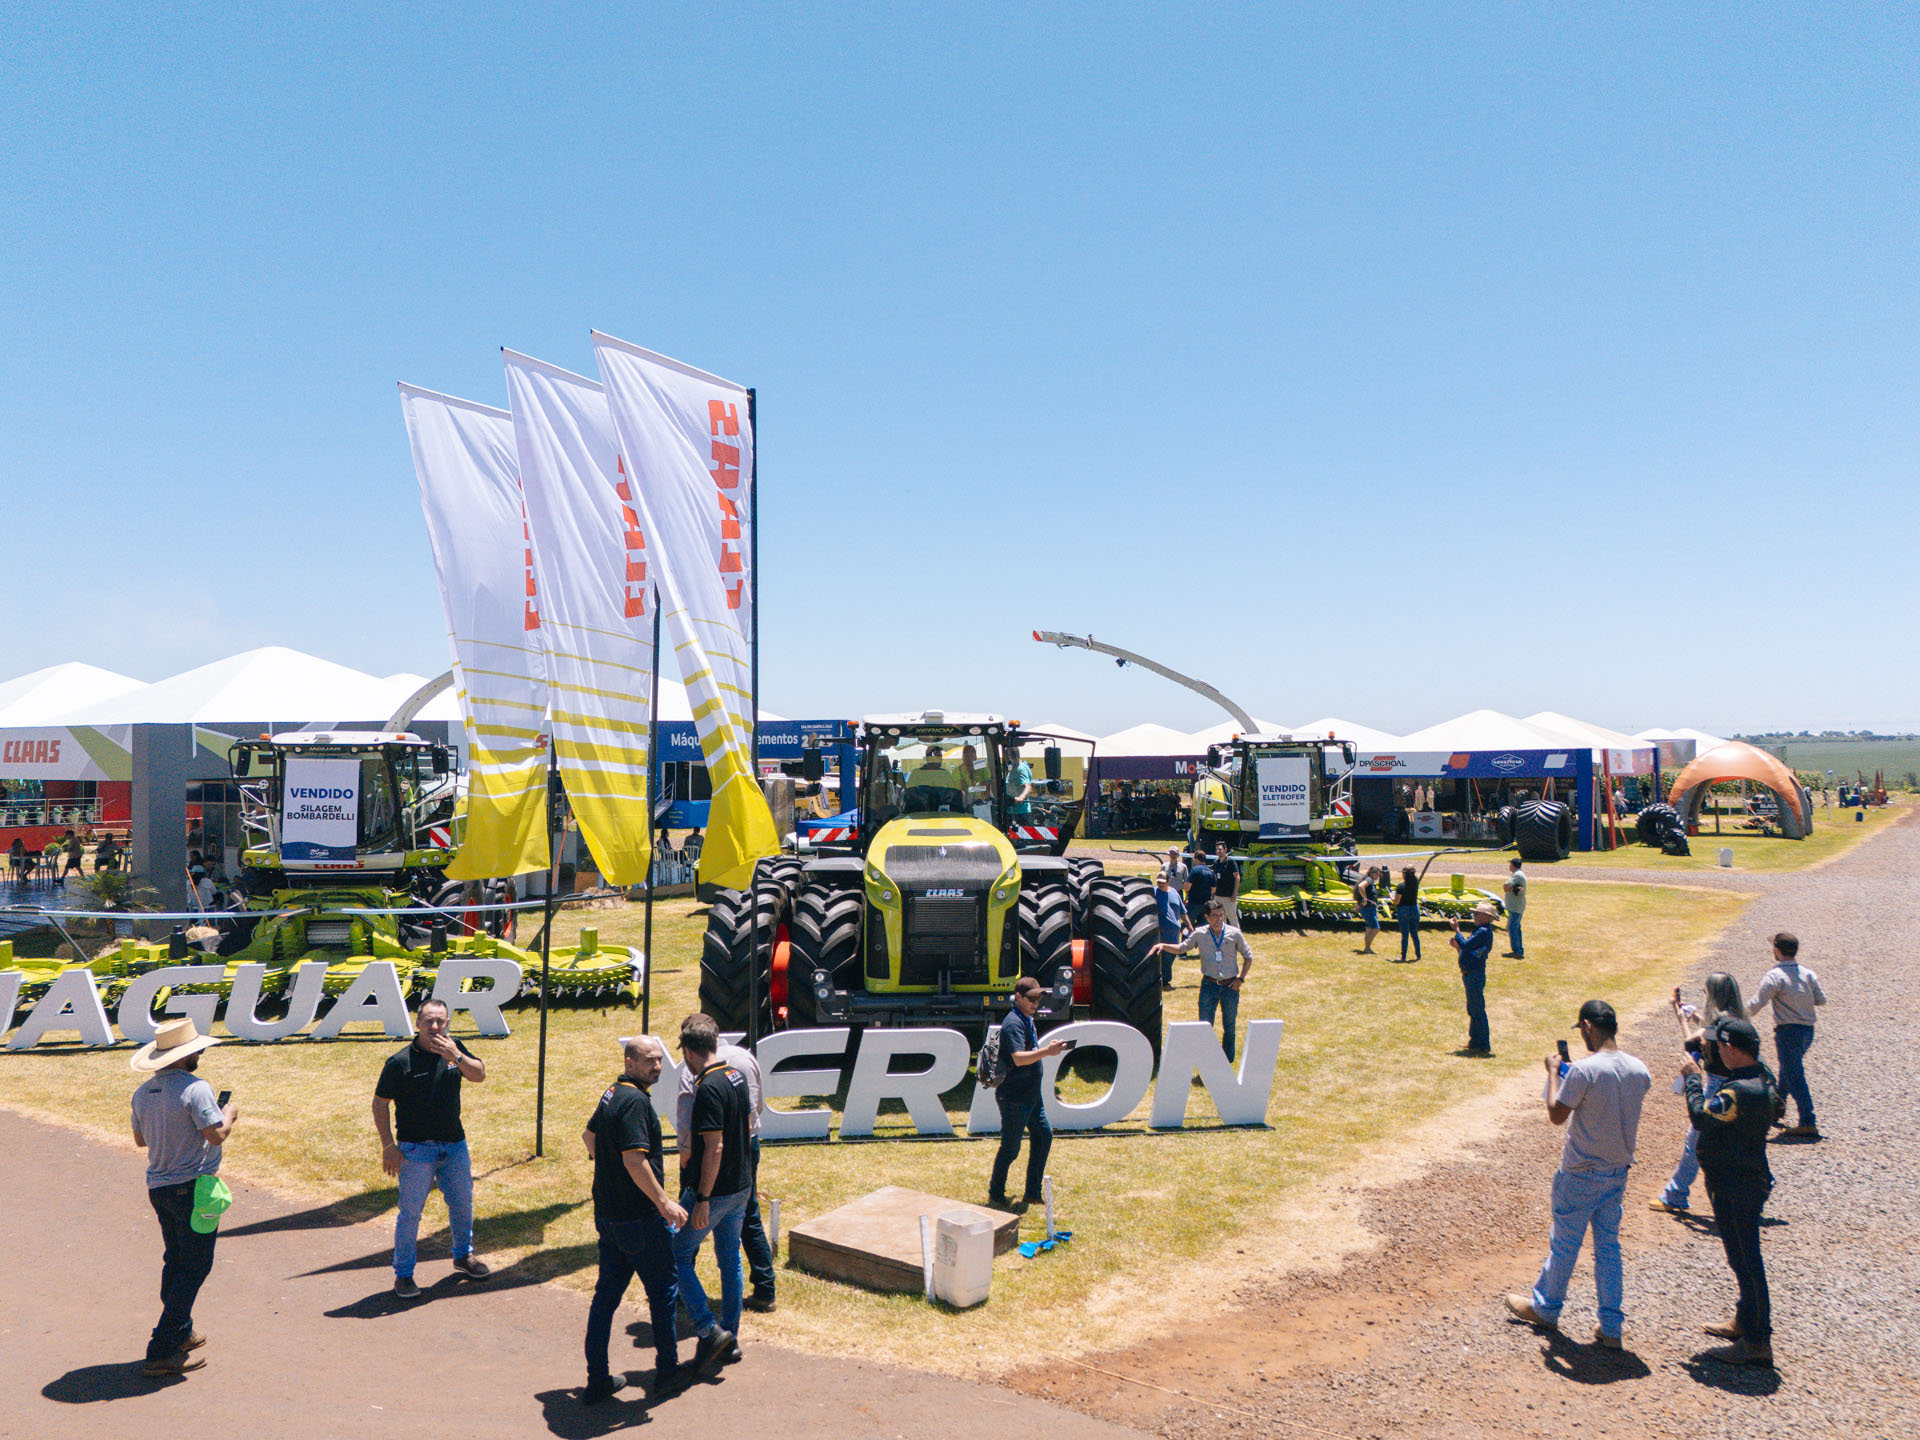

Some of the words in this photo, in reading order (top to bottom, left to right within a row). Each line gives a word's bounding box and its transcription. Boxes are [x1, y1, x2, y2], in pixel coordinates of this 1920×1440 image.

[671, 732, 701, 749] Máqu
[757, 734, 798, 745] ementos
[3, 740, 61, 763] CLAAS
[1262, 784, 1306, 792] VENDIDO
[290, 788, 354, 799] VENDIDO
[300, 804, 342, 812] SILAGEM
[287, 812, 355, 820] BOMBARDELLI
[925, 888, 964, 897] CLAAS
